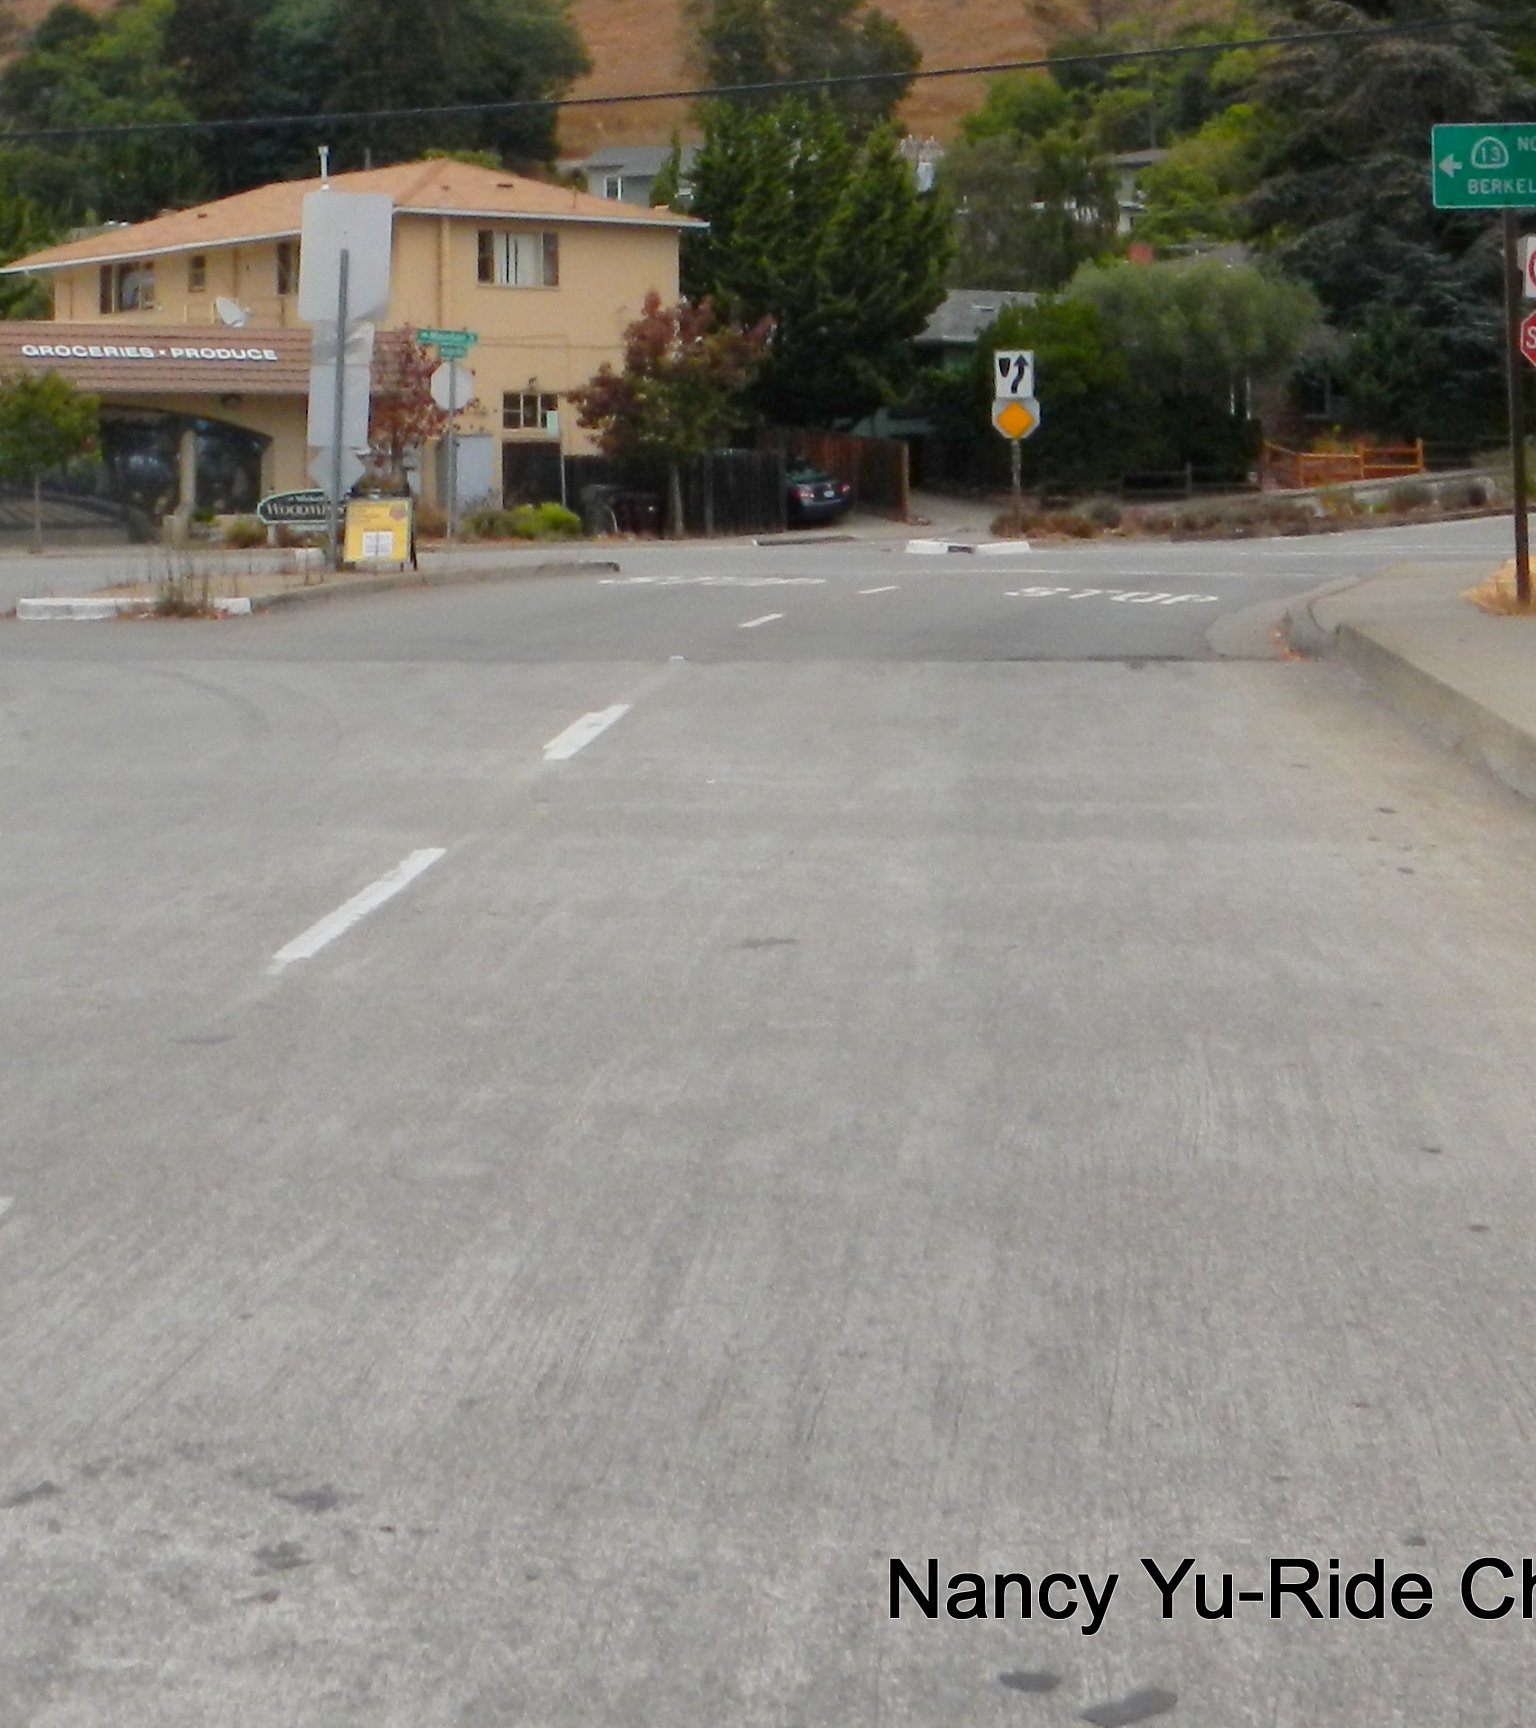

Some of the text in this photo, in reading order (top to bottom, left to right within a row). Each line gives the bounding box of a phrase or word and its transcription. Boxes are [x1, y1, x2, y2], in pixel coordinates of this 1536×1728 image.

[1480, 146, 1501, 163] 13
[21, 344, 278, 362] GROCERIES PRODUCE
[1003, 586, 1219, 604] STOP
